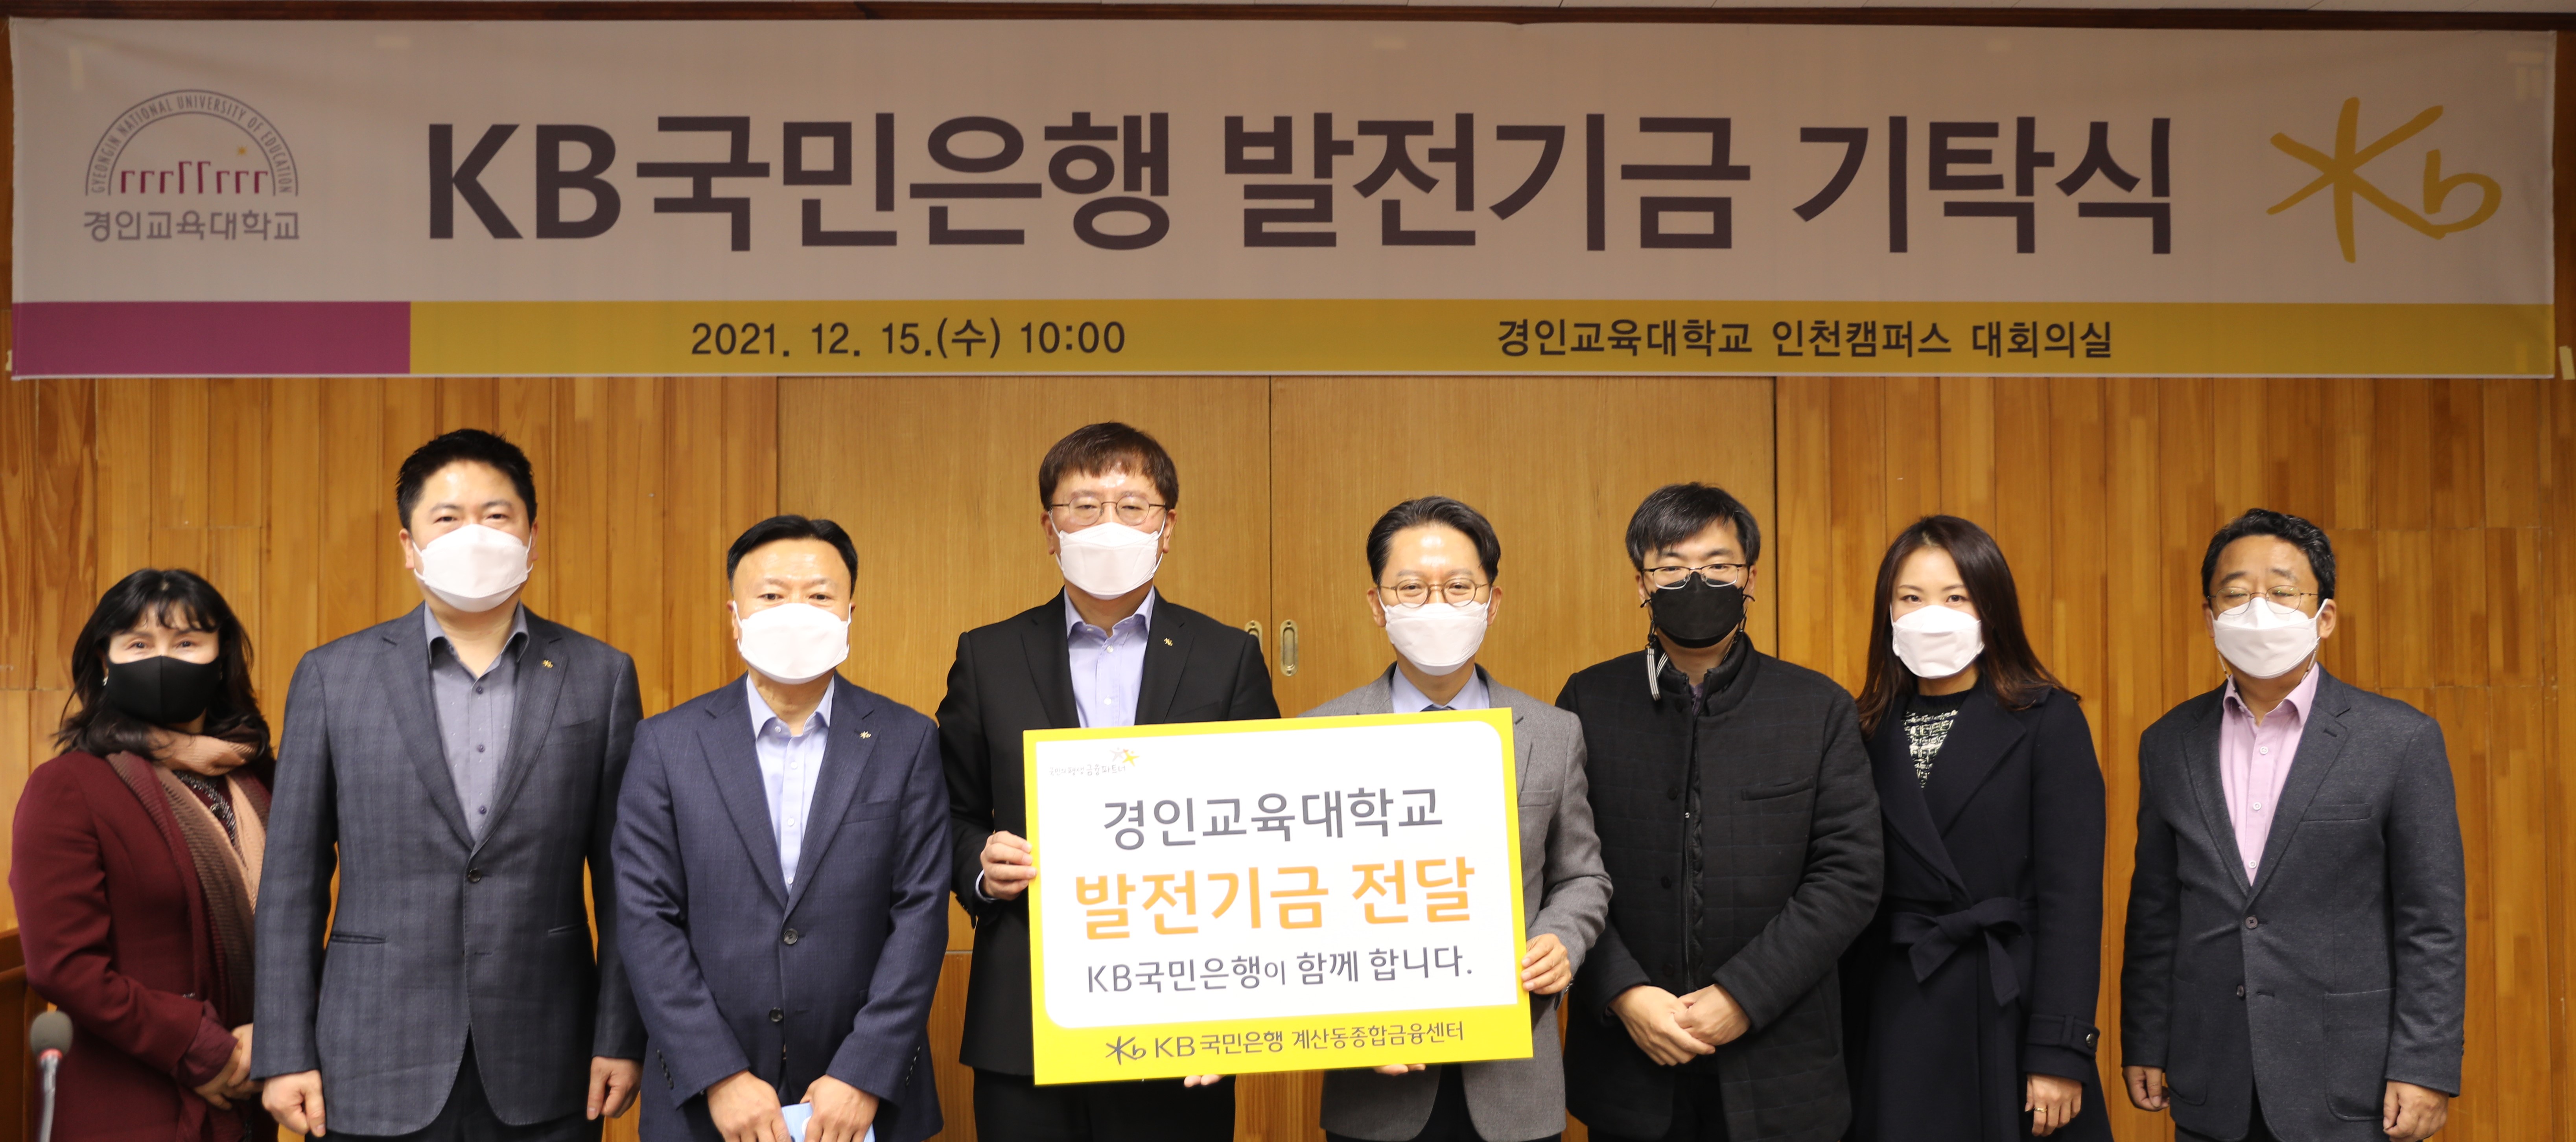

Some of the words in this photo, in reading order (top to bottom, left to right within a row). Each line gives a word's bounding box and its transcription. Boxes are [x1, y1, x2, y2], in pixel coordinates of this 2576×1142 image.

[91, 136, 121, 193] GYEONGIN
[117, 98, 173, 137] NATIONAL
[177, 94, 247, 121] UNIVERSITY
[247, 117, 263, 132] OF
[260, 131, 293, 193] EDUCATION
[429, 112, 1170, 252] KB국민은행
[1224, 112, 1751, 251] 발전기금
[1793, 116, 2171, 254] 기탁식
[83, 210, 299, 243] 경인교육대학교
[692, 322, 789, 357] 2021.
[811, 322, 860, 357] 12.
[1021, 321, 1125, 353] 10:00
[1498, 319, 1752, 357] 경인교육대학교
[1773, 320, 1951, 358] 인천캠퍼스
[1972, 321, 2111, 358] 대회의실
[1104, 787, 1443, 850] 경인교육대학교
[1076, 866, 1329, 940] 발전기금
[1352, 857, 1475, 924] 전달
[1088, 955, 1285, 993] KB국민은행이
[1297, 951, 1358, 985] 함께
[1369, 945, 1472, 981] 합니다.
[1292, 1021, 1463, 1049] 계산동종합금융센터
